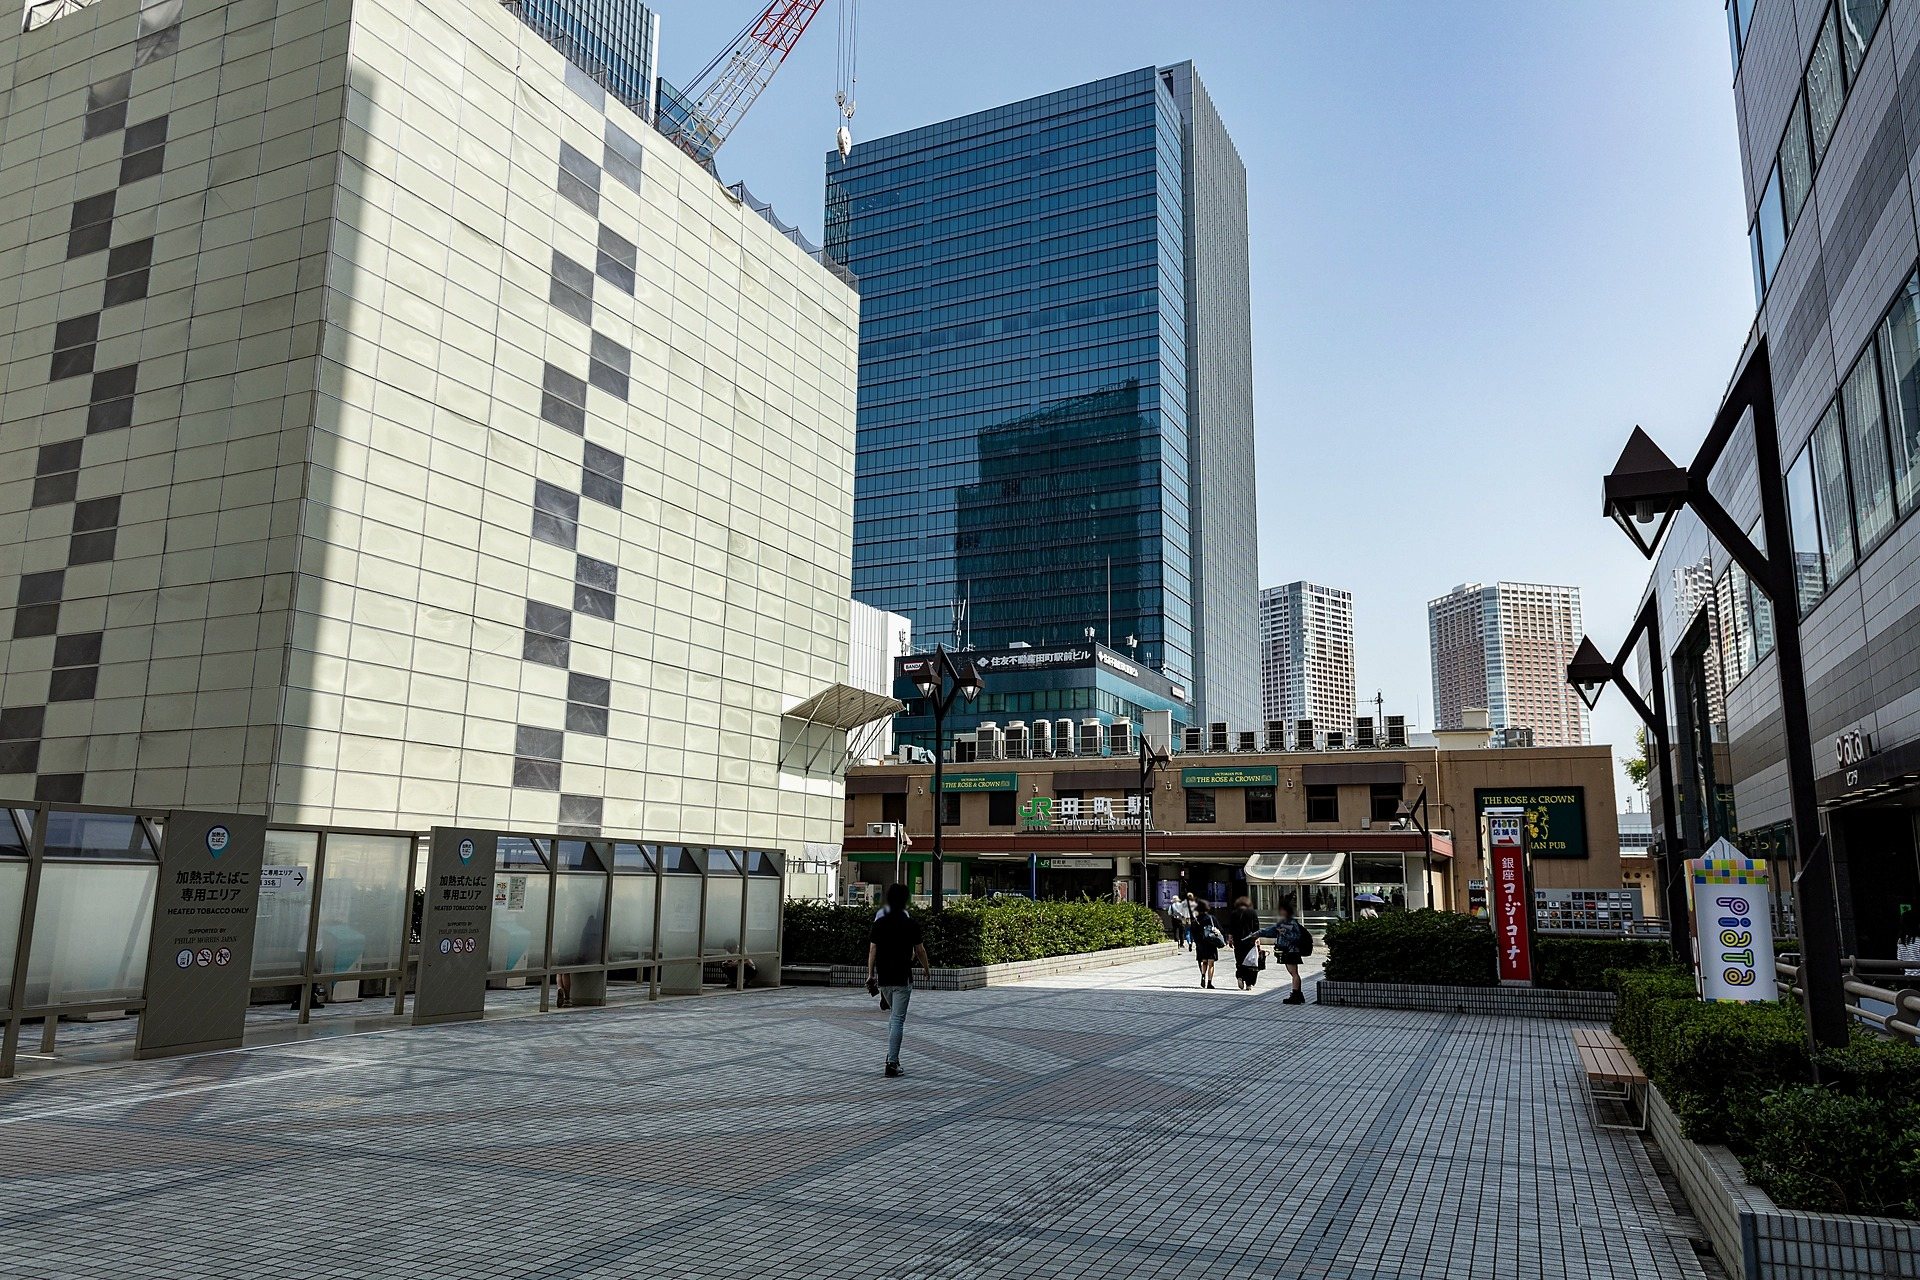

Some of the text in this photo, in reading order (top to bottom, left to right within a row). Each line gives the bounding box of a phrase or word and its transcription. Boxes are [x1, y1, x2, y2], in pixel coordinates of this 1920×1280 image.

[1482, 795, 1575, 805] THE ROSE & CROWN
[1018, 797, 1052, 817] JR
[1061, 817, 1108, 826] Tamachi
[1109, 817, 1143, 826] Statio
[1549, 841, 1567, 849] PUB
[175, 870, 250, 885] 加熱式たばこ
[439, 875, 487, 887] 加熱式たばこ
[180, 888, 241, 902] 専用エリア
[442, 889, 482, 901] 専用エリア
[197, 907, 230, 915] TOBACCO
[1501, 857, 1521, 969] 銀座コージーコーナー
